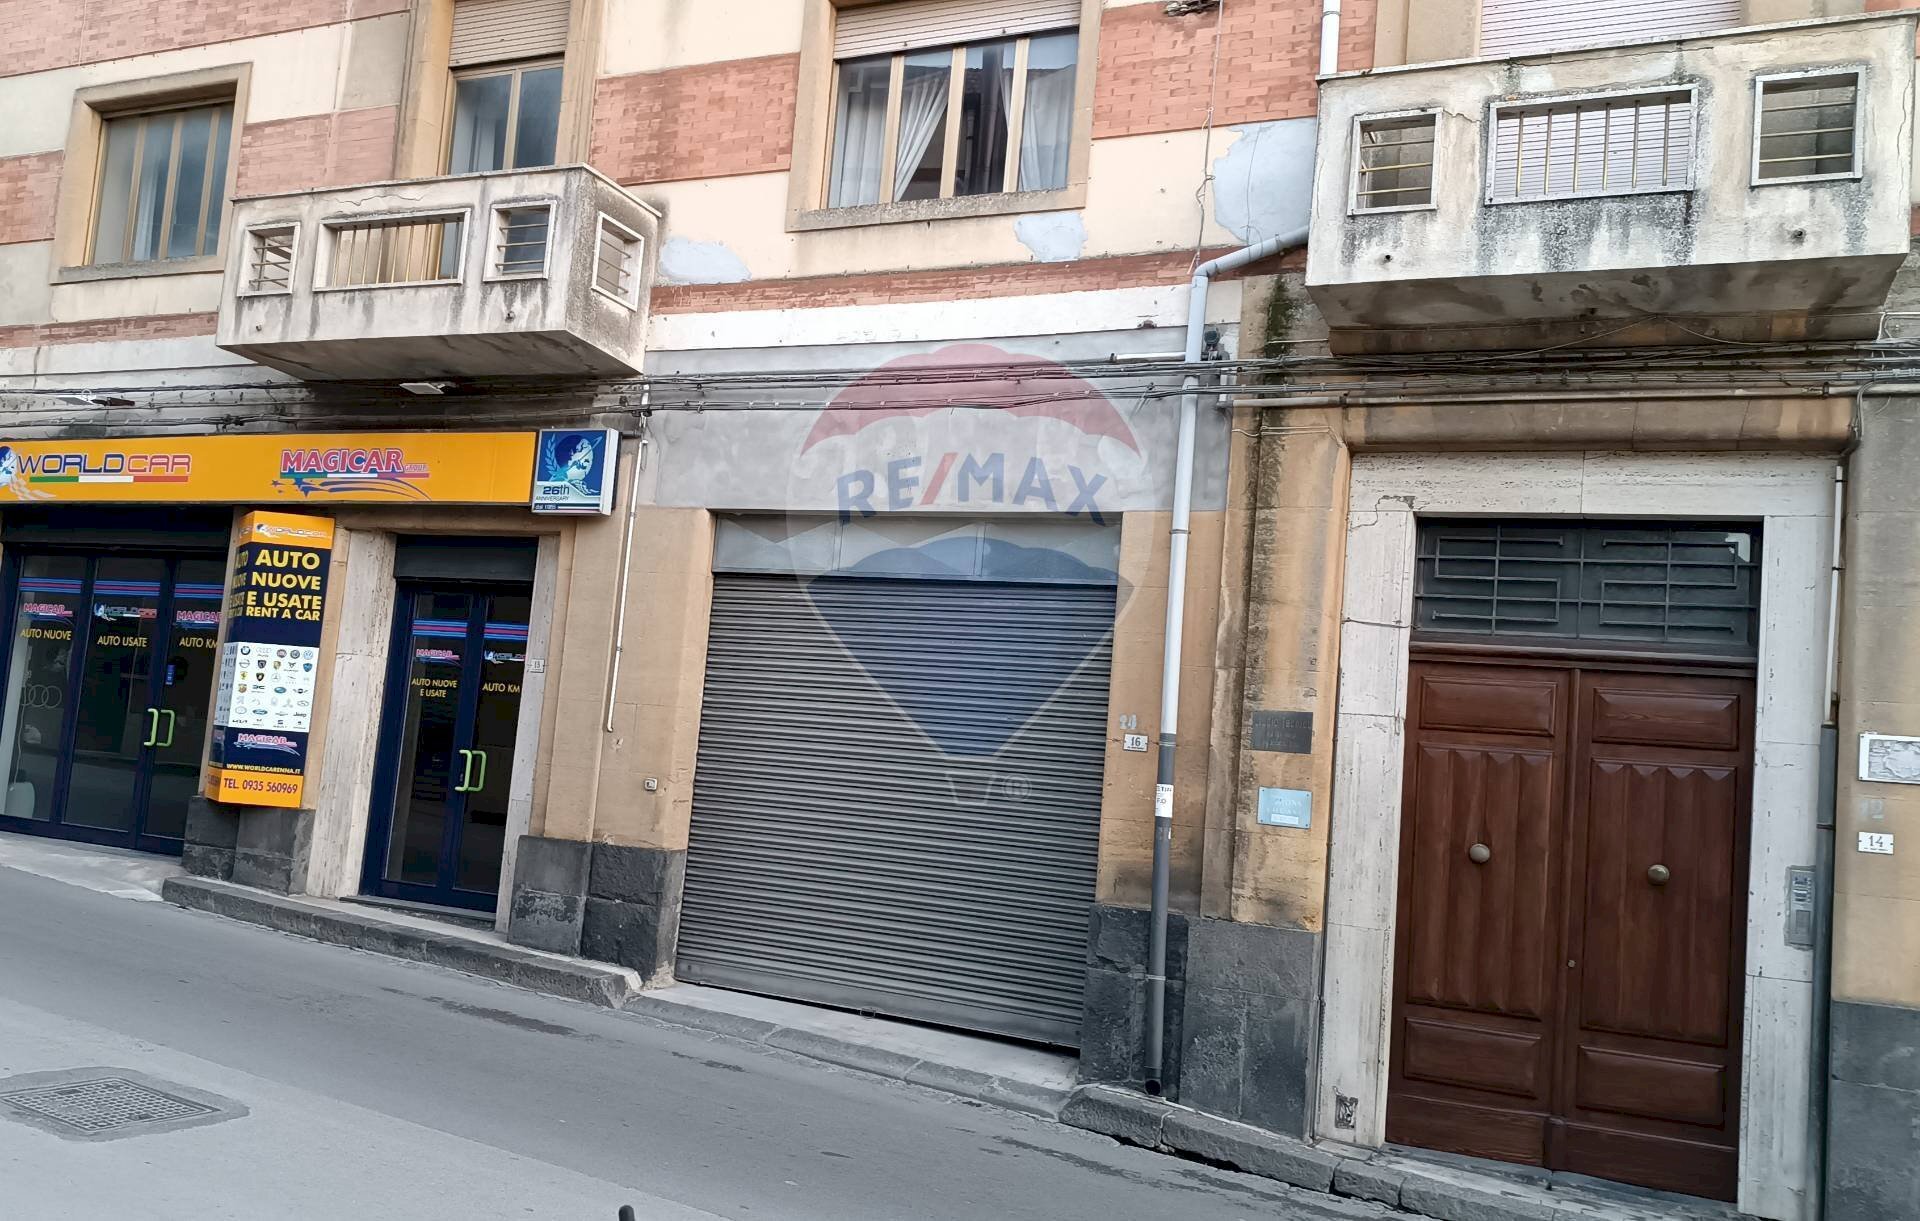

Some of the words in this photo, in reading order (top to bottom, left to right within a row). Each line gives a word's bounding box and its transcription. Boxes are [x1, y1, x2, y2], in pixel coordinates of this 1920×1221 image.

[280, 448, 404, 473] MAGICAR
[543, 485, 570, 495] 26th
[255, 549, 321, 570] AUTO
[251, 572, 322, 590] NUOVE
[246, 591, 258, 605] E
[264, 592, 322, 610] USATE
[246, 607, 279, 618] RENT
[281, 609, 292, 619] A
[295, 610, 321, 621] CAR
[20, 628, 42, 639] AUTO
[43, 630, 73, 641] NUOVE
[97, 635, 121, 646] AUTO
[122, 637, 148, 647] USATE
[179, 638, 204, 648] AUTO
[411, 678, 431, 687] AUTO
[432, 679, 458, 688] NUOVE
[482, 683, 506, 692] AUTO
[508, 684, 521, 693] KM
[1130, 736, 1141, 747] 16
[242, 779, 264, 791] 0935
[266, 781, 298, 794] 560969
[1868, 835, 1884, 847] 14
